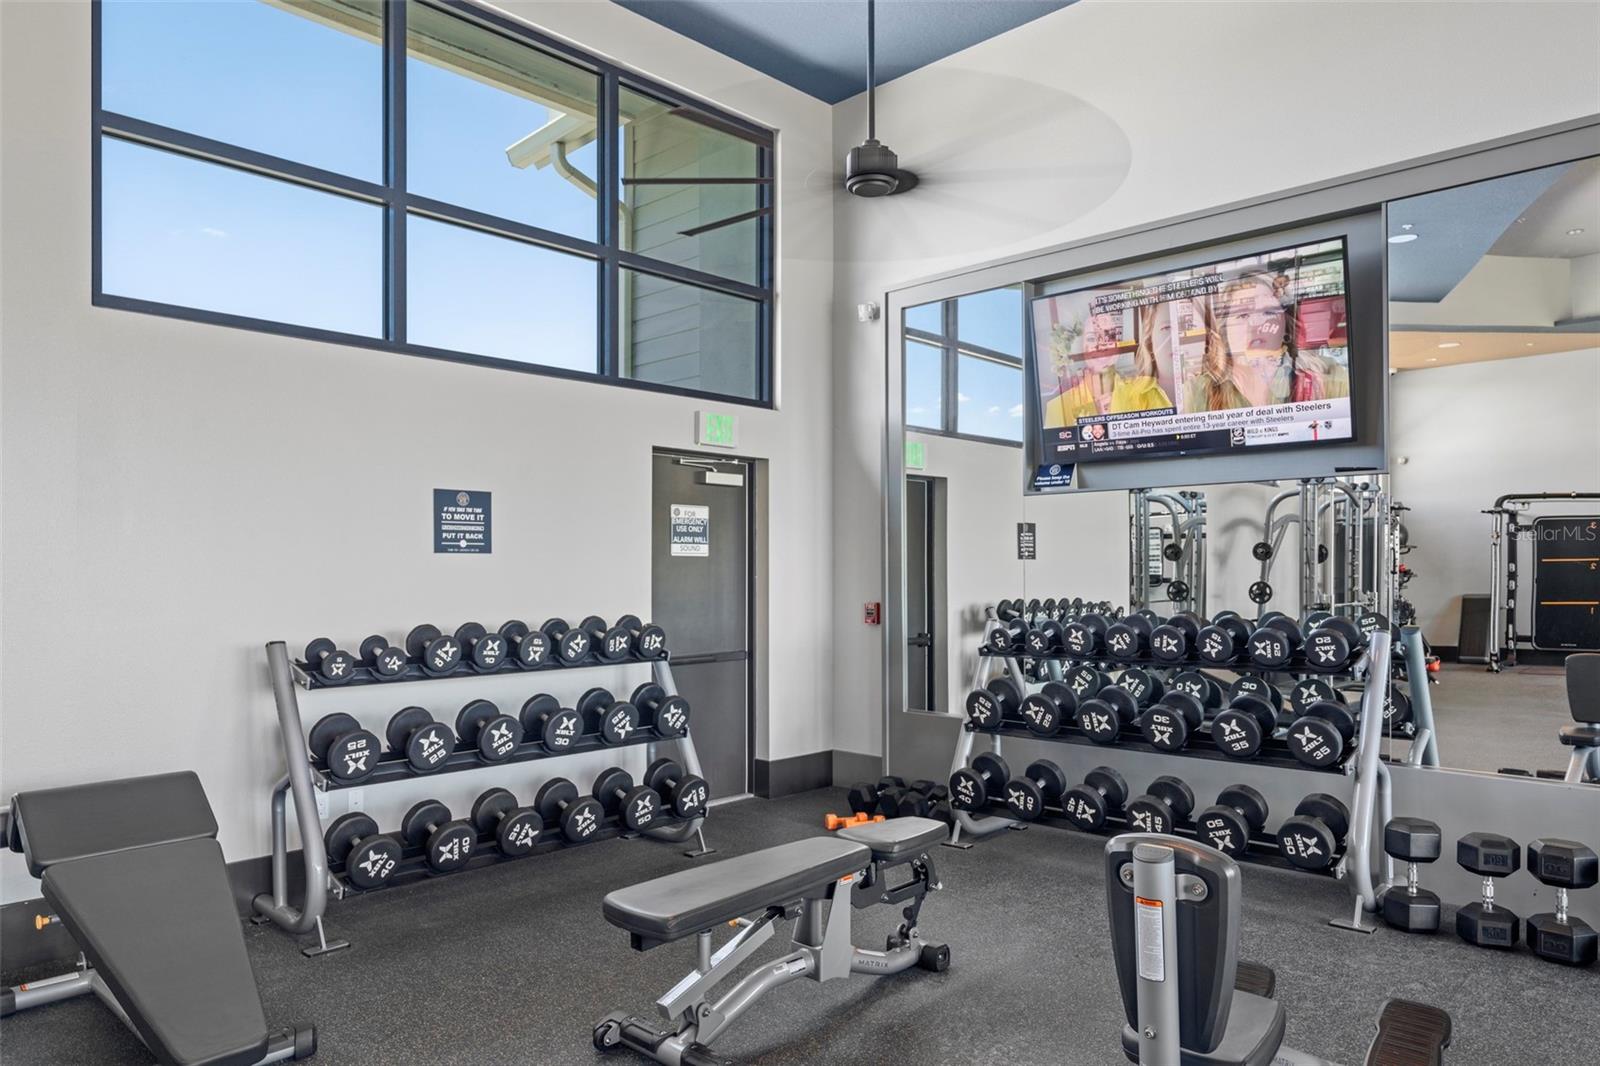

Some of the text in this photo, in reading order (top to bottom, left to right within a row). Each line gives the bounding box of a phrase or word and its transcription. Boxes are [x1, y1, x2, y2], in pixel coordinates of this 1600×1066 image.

[1112, 402, 1332, 430] DT Cam Heyward entering final year of deal with Steelers
[1265, 414, 1295, 424] Steelers
[453, 513, 475, 521] MOVE
[676, 524, 704, 533] USE ONLY
[1043, 713, 1053, 728] 25
[1082, 714, 1091, 730] 30
[1153, 714, 1170, 724] 30
[554, 728, 576, 736] XULT
[1150, 724, 1174, 733] XULT
[1223, 730, 1247, 742] XULT
[347, 739, 367, 750] 25
[491, 731, 513, 749] XULT
[554, 737, 570, 746] 30
[1231, 740, 1249, 751] 35
[1302, 735, 1325, 752] XULT
[343, 749, 371, 761] XULT
[421, 738, 444, 758] XULT
[498, 742, 514, 756] 30
[1313, 745, 1331, 760] 35
[429, 749, 446, 764] 25
[958, 793, 972, 804] 40
[1026, 796, 1034, 811] 40
[1066, 797, 1076, 812] 45
[576, 813, 596, 833] XULT
[637, 813, 652, 825] 50
[1154, 816, 1163, 832] 45
[1206, 819, 1225, 829] 50
[582, 822, 597, 837] 45
[1208, 828, 1232, 838] XULT
[462, 836, 470, 853] 40
[1283, 837, 1296, 855] 50
[1294, 833, 1308, 859] XULT
[367, 851, 389, 878] XULT
[381, 859, 396, 878] 40
[859, 959, 889, 968] MATRIX
